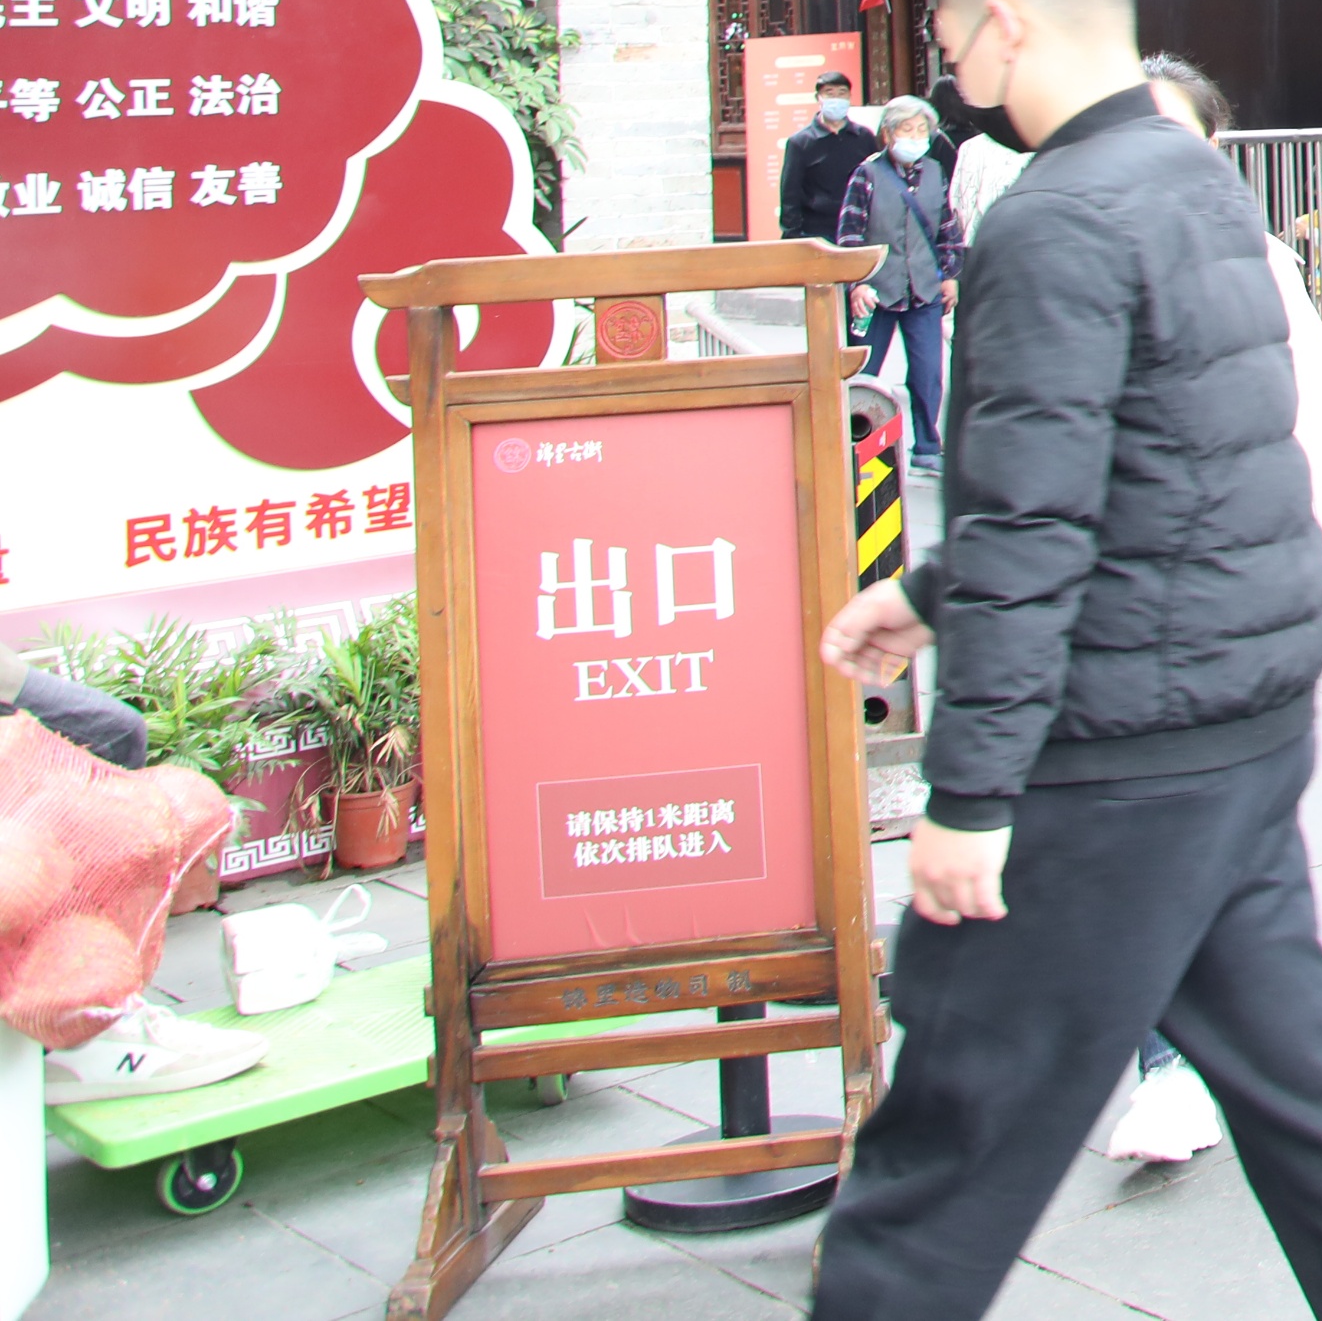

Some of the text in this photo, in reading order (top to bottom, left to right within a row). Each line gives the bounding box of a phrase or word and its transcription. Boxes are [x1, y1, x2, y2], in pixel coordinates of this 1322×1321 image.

[0, 73, 282, 122] 等 公正 法治
[77, 167, 175, 214] 诚信
[190, 161, 284, 207] 友善
[125, 480, 413, 568] 民族有希望
[535, 536, 737, 642] 出口
[572, 648, 716, 703] EXIT
[565, 798, 736, 838] 请保持1米距离
[573, 829, 732, 868] 依次排队进入
[117, 1051, 147, 1073] N
